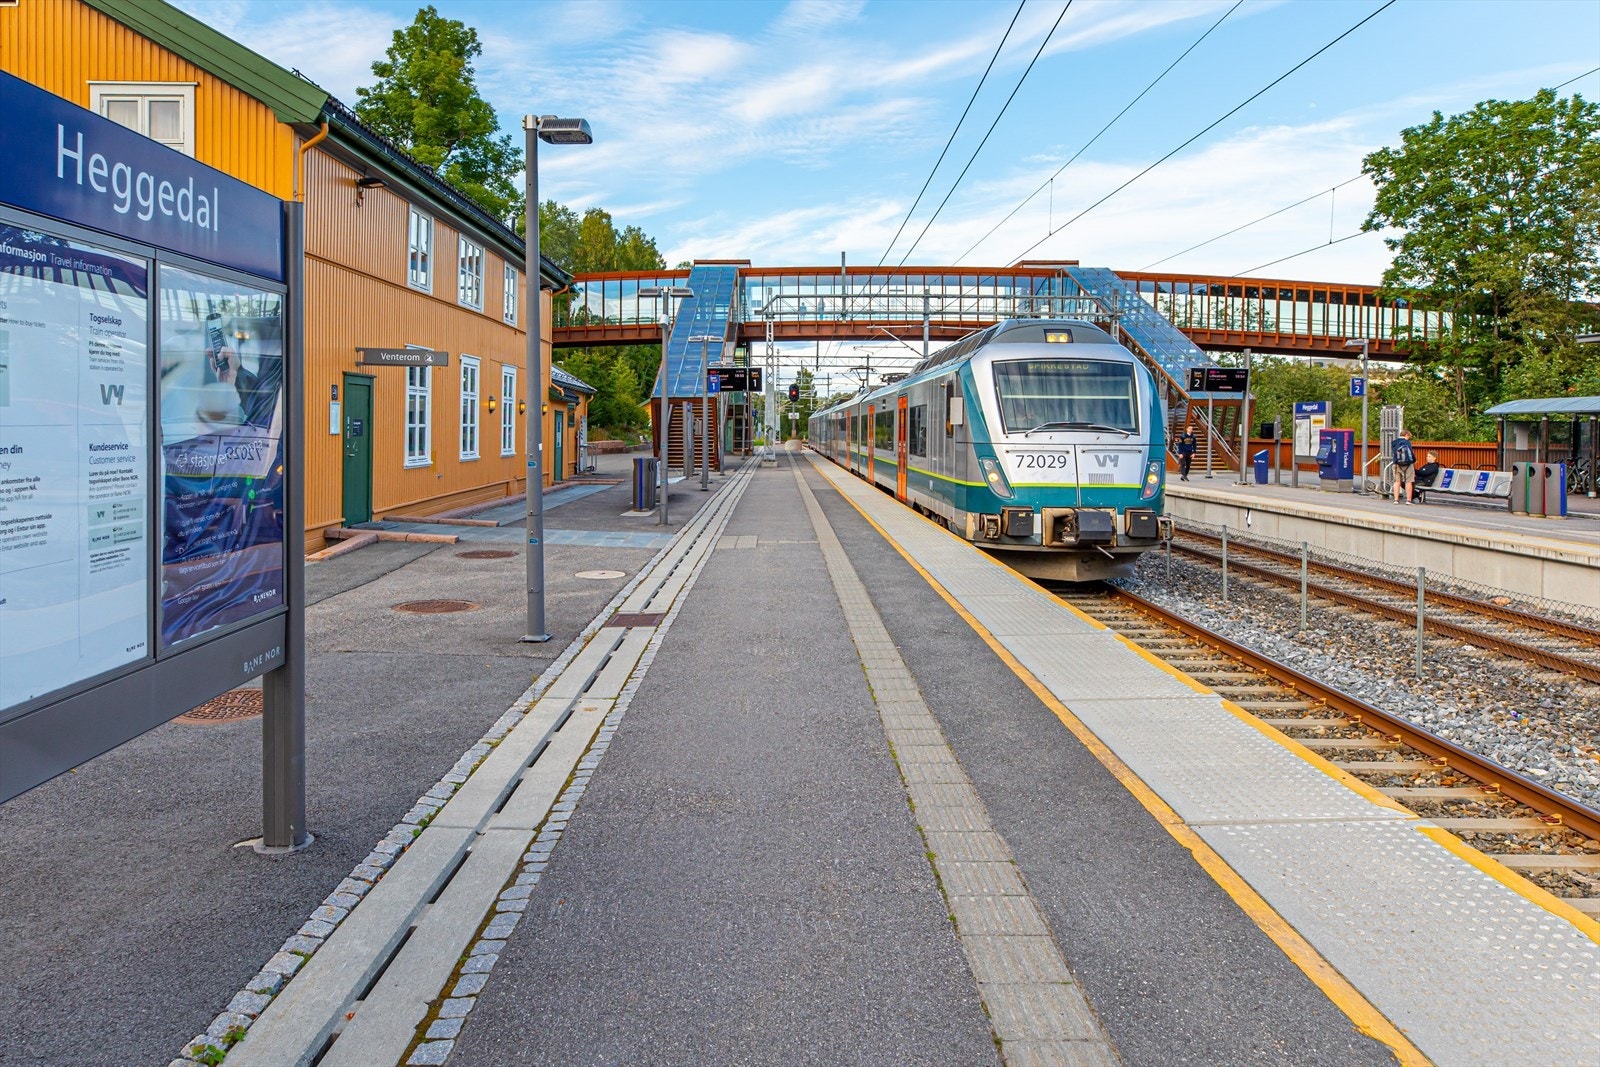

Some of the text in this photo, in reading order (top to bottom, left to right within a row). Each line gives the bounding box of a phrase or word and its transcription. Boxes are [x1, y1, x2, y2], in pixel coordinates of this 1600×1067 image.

[57, 123, 218, 231] Heggedal
[50, 252, 72, 268] Travel
[73, 258, 113, 276] information
[89, 312, 123, 327] Togselskap
[89, 326, 127, 338] Train operator
[380, 352, 420, 361] Venterom
[753, 379, 757, 387] 1
[1194, 379, 1200, 388] 2
[1354, 385, 1360, 394] 2
[10, 444, 23, 454] din
[89, 442, 129, 451] Kundeservice
[89, 454, 136, 465] Customer service
[1015, 454, 1067, 469] 72029
[243, 646, 281, 674] BANE NOR
